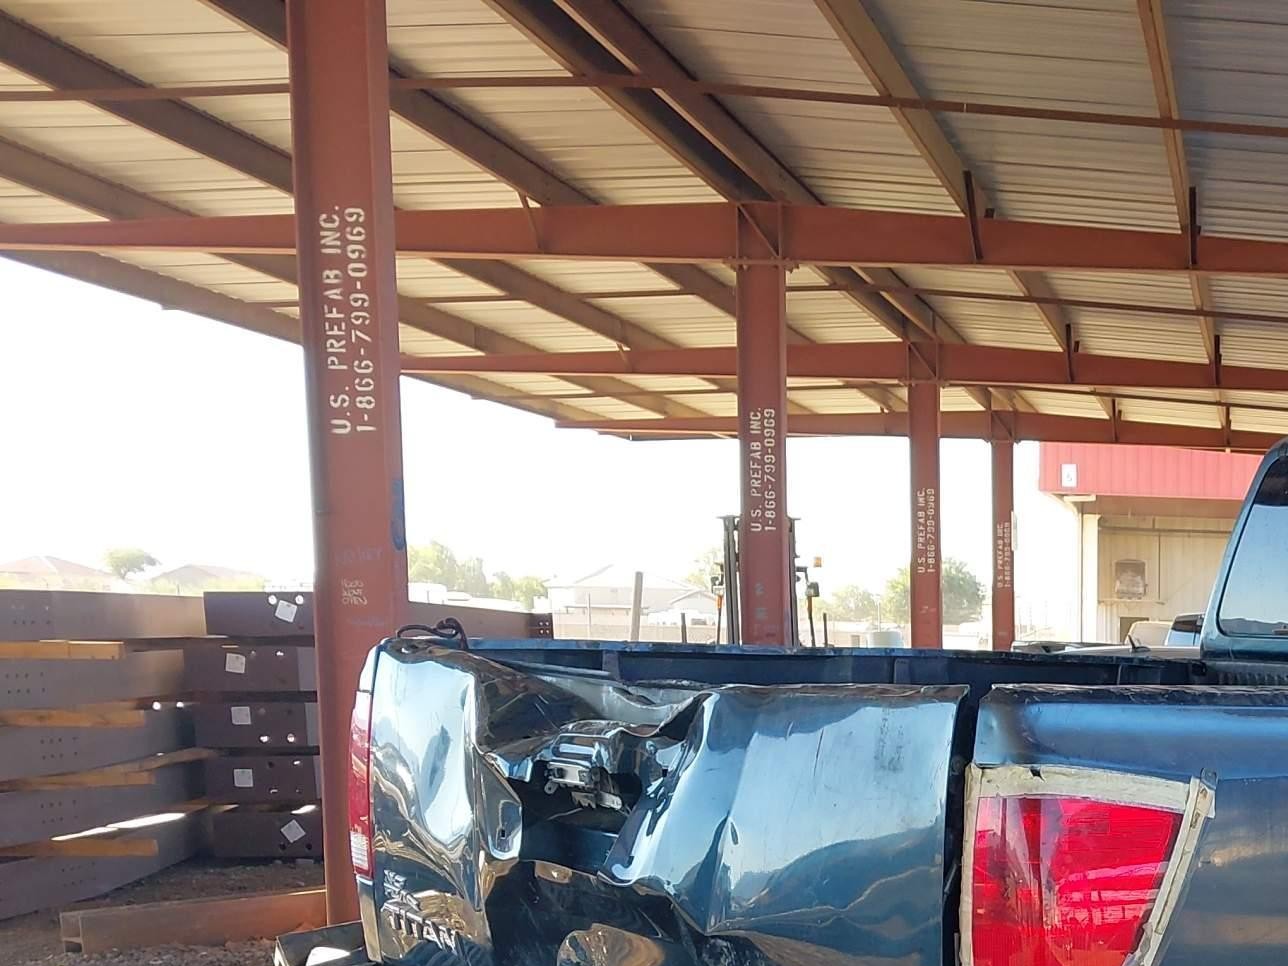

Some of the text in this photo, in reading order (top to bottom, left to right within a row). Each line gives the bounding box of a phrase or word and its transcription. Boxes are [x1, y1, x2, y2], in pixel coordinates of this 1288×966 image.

[319, 205, 351, 434] U.S. PREFAB INC.
[344, 207, 377, 432] 1-866-799-0969
[750, 407, 763, 532] U.S. PREFAB INC.
[764, 408, 776, 531] 1-866-799-0969
[917, 488, 926, 506] INC.
[917, 511, 926, 550] PREFAB
[381, 903, 459, 955] TITAN
